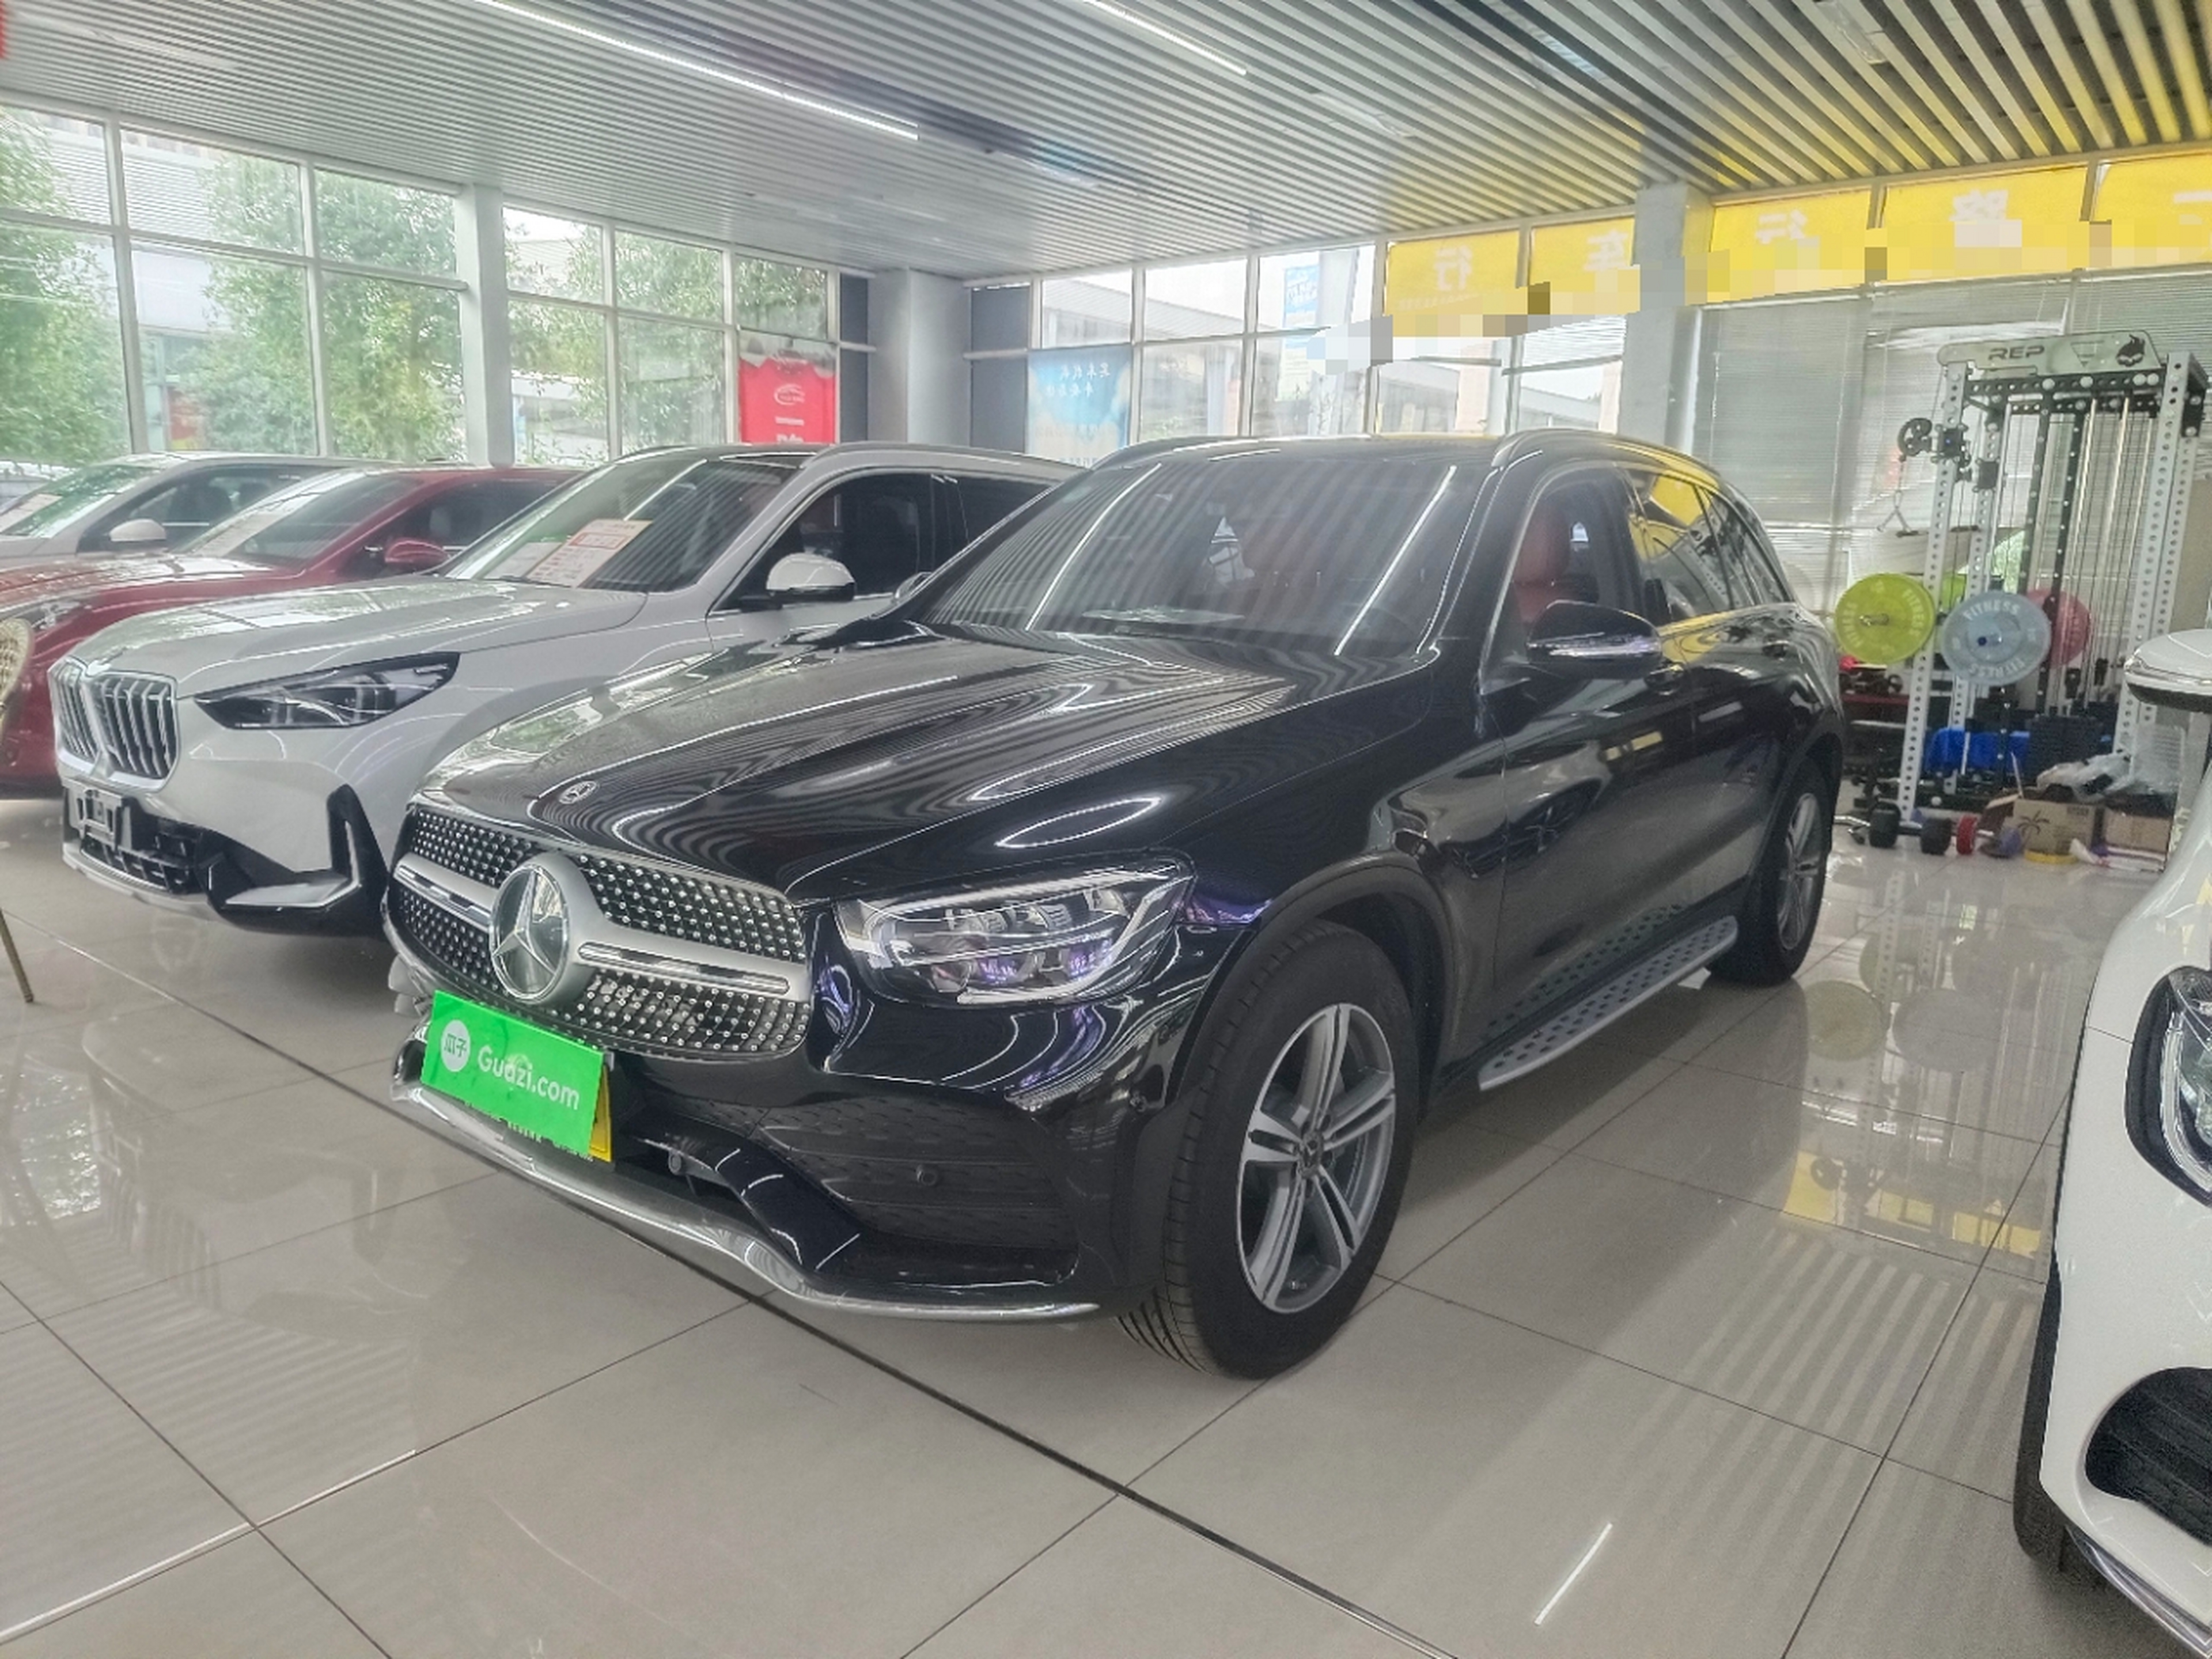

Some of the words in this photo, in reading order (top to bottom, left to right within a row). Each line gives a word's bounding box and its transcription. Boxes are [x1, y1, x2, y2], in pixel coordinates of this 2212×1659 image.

[1988, 344, 2045, 361] REP
[1962, 599, 2021, 622] FITNESS
[1968, 656, 2025, 678] FITNESS
